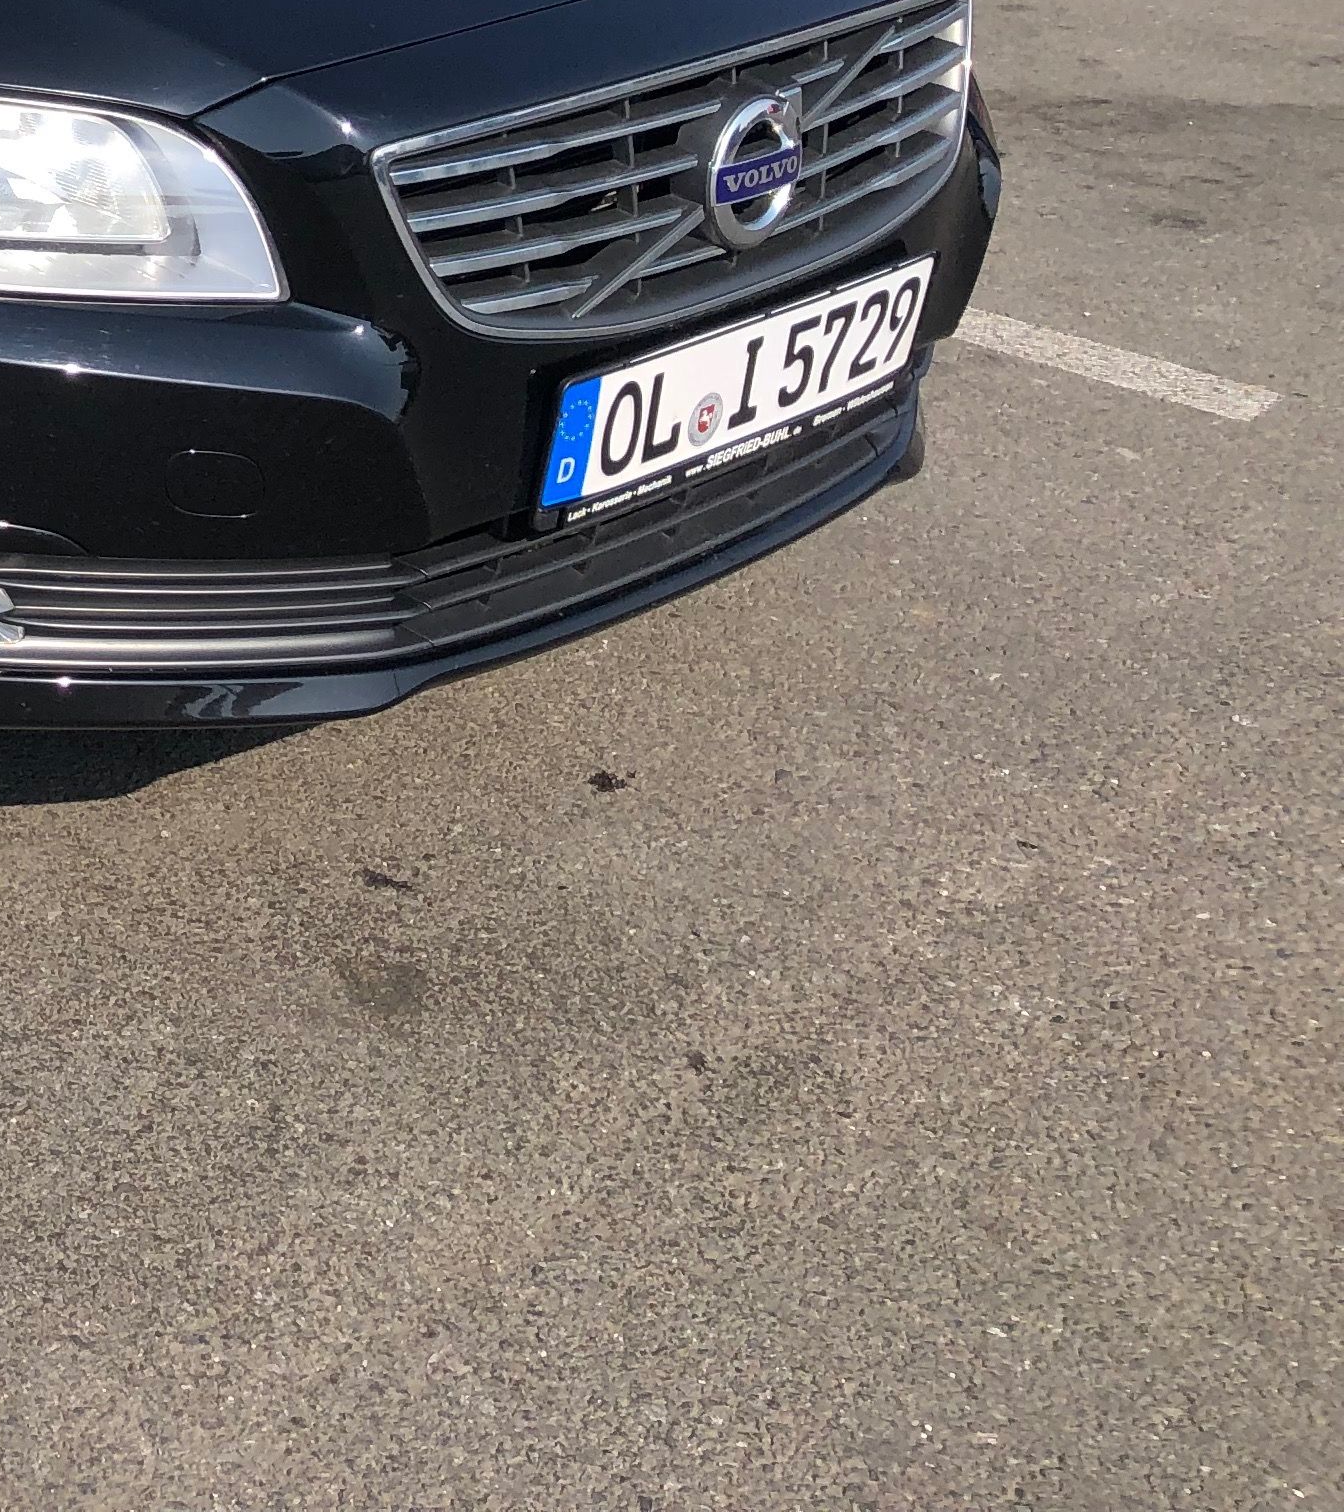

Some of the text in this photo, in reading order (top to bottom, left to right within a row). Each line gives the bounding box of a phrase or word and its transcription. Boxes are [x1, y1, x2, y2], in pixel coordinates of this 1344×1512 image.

[723, 155, 798, 193] VOLVO
[600, 276, 921, 477] OL I 5729
[556, 457, 576, 484] D
